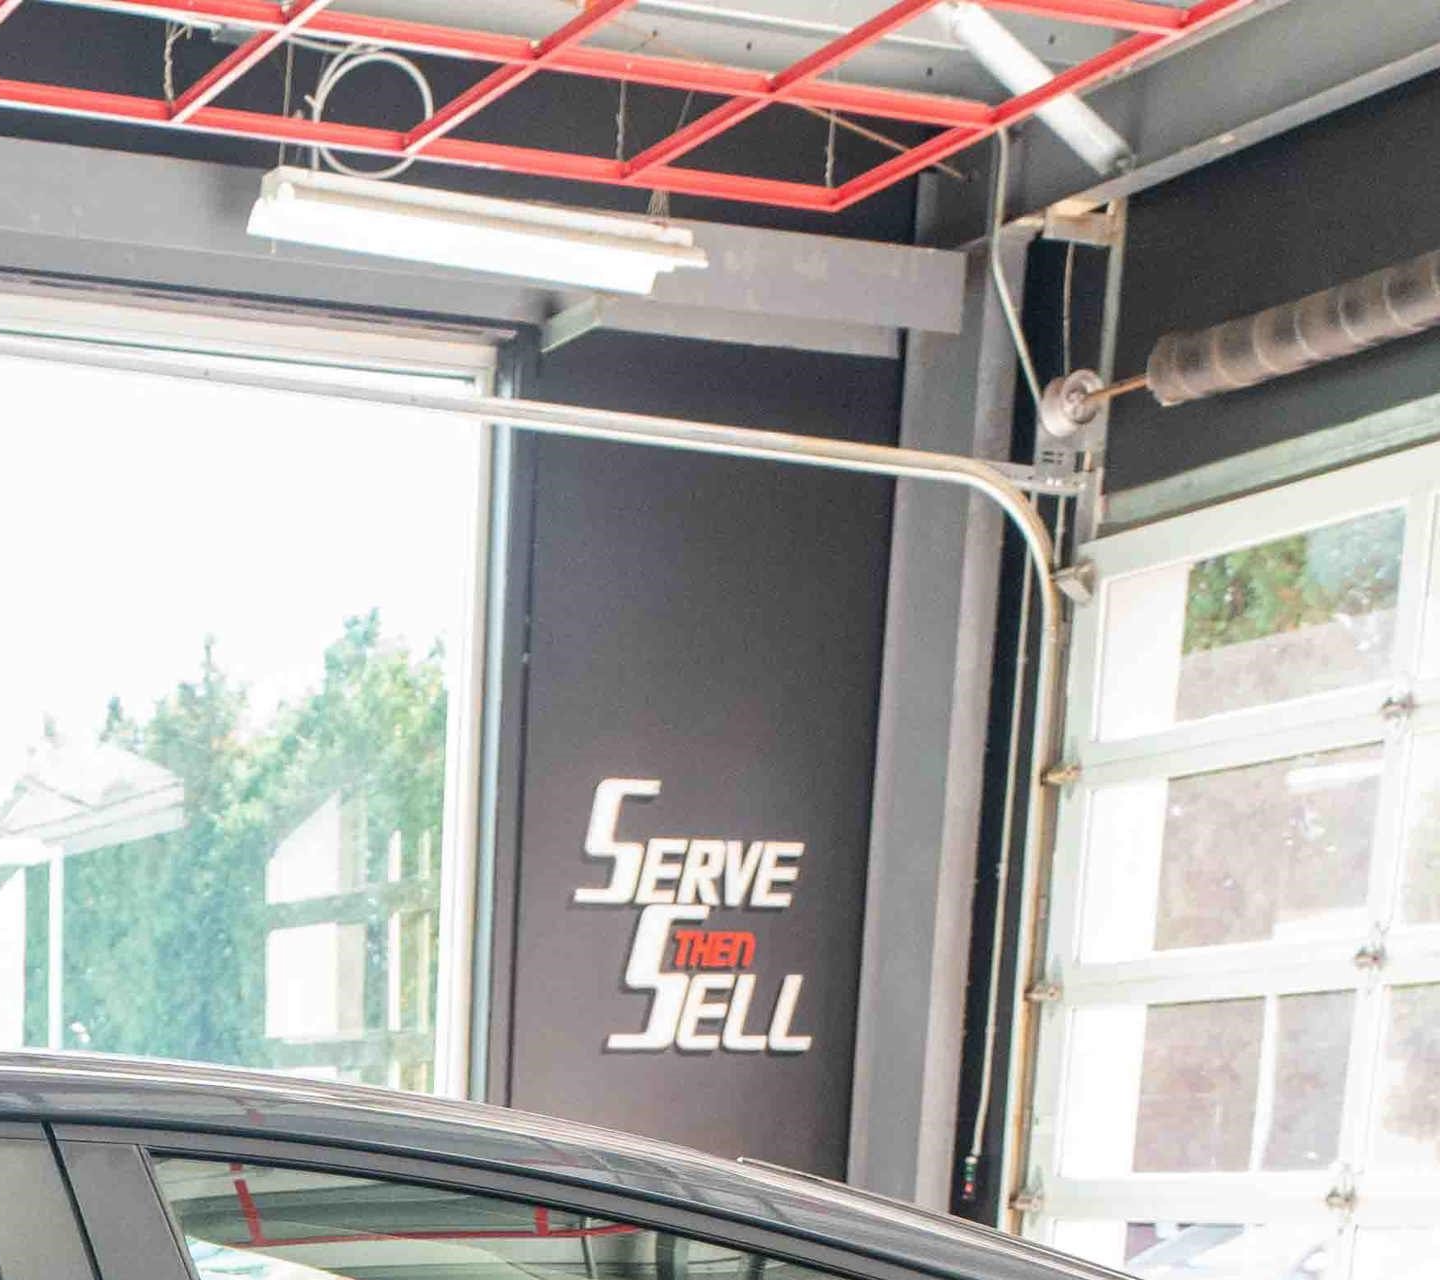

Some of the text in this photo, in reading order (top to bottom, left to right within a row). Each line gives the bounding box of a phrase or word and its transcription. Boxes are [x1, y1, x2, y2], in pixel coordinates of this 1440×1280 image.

[573, 777, 805, 907] SERVE
[606, 904, 814, 1052] SELL
[675, 930, 757, 968] THEN
